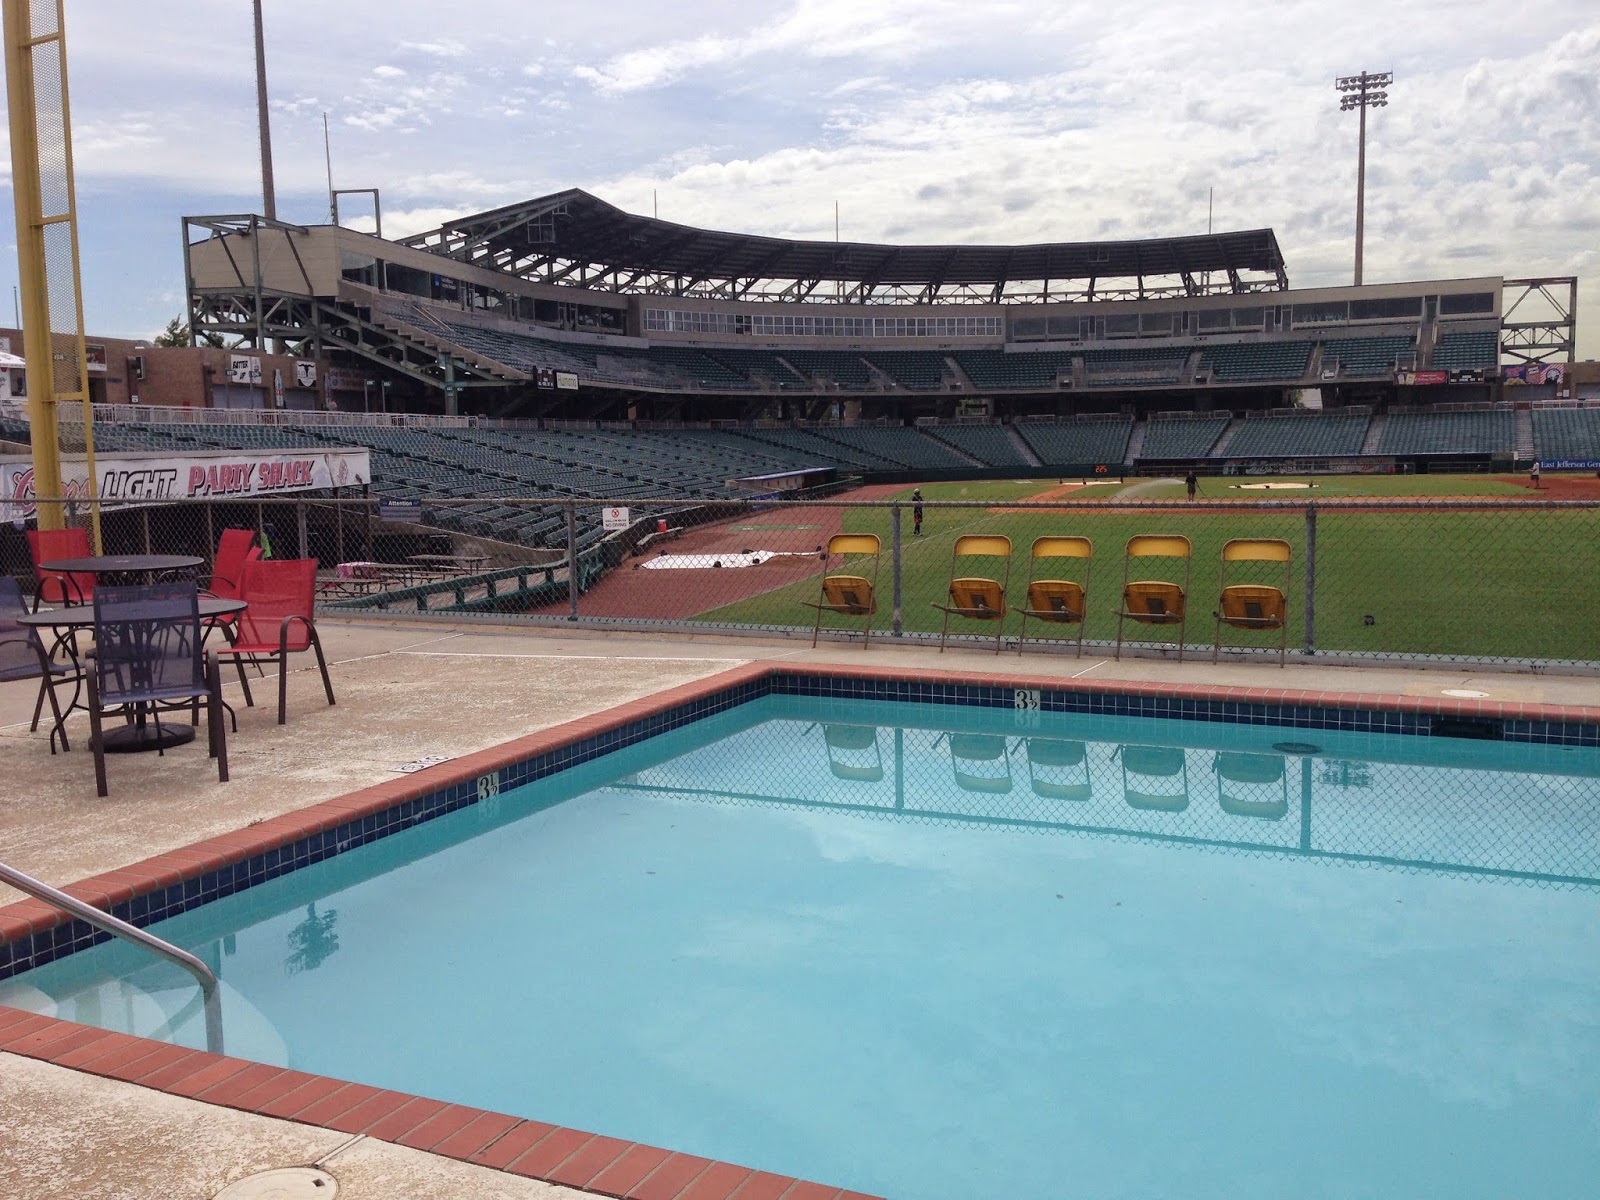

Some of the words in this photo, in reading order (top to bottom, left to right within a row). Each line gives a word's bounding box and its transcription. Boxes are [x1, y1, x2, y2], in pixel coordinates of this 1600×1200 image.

[232, 360, 248, 369] BATTER
[1556, 460, 1586, 469] Jefferson
[101, 468, 177, 505] LIGHT
[187, 463, 256, 497] PARTY
[257, 460, 315, 491] SHACK
